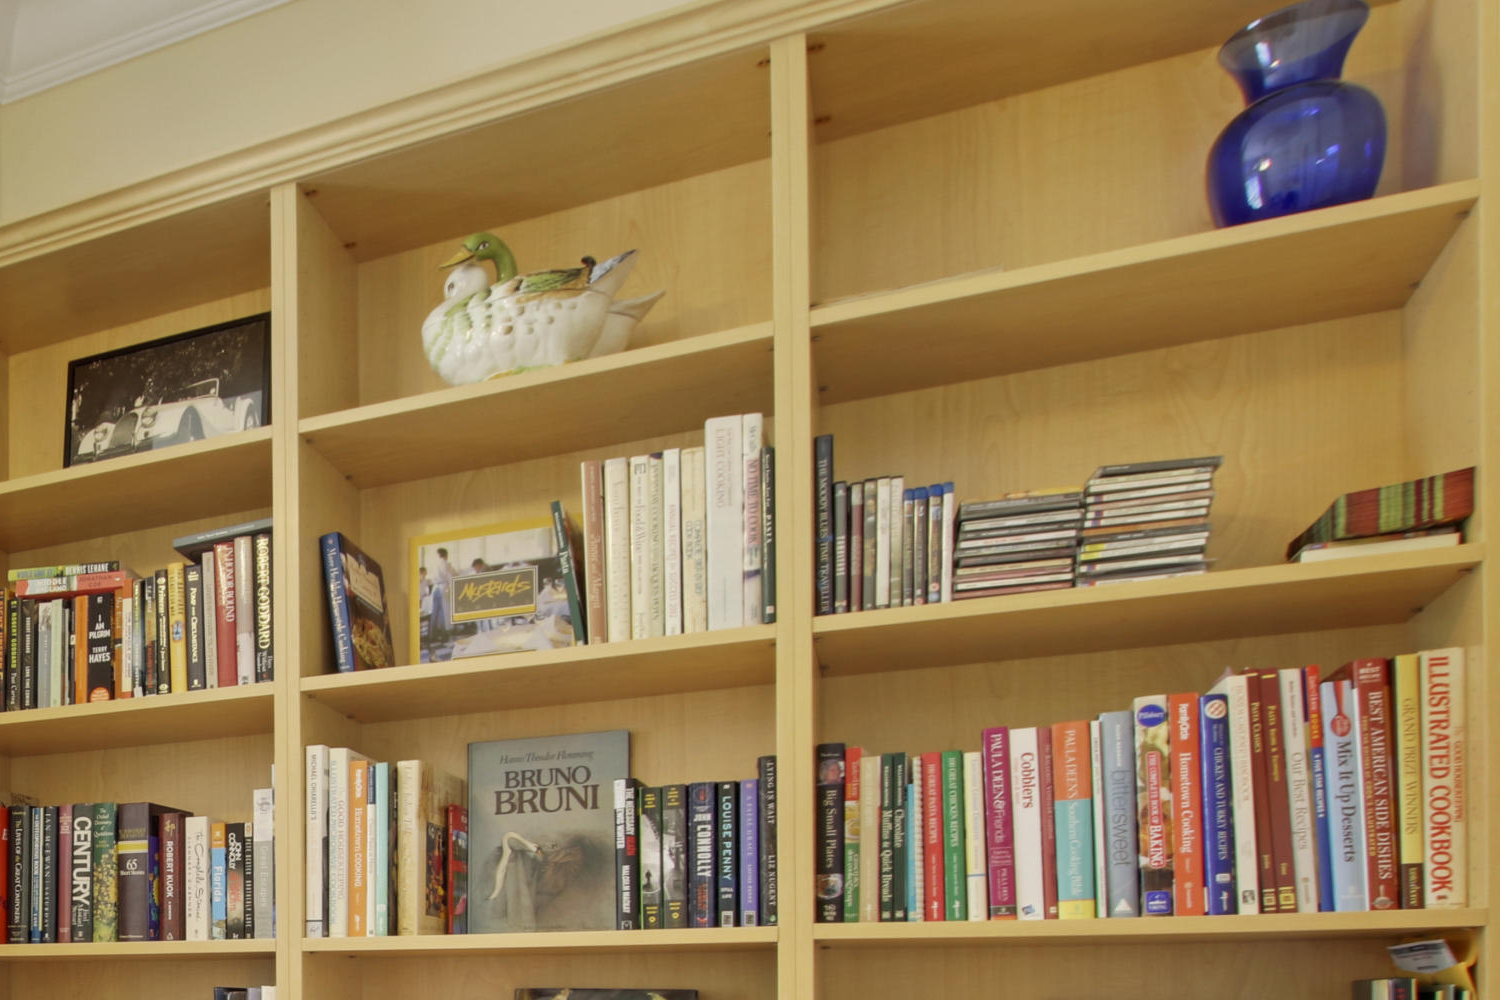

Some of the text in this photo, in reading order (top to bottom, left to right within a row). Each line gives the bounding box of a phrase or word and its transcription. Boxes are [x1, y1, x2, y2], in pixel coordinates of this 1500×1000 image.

[820, 512, 828, 539] BLUES
[256, 538, 269, 649] ROBERT GODDARD
[89, 629, 110, 638] PILGRIM
[95, 622, 104, 630] AM
[89, 652, 111, 663] HAYES
[990, 733, 1003, 769] PAULA
[1065, 729, 1077, 763] PAULA
[1213, 747, 1224, 781] CHICKEN
[505, 765, 591, 788] BRUNO
[1020, 752, 1035, 809] Cobblers
[1401, 697, 1418, 835] GRAND PRIZE WINNERS
[1427, 656, 1453, 893] ILLUSTRATED COOKBOOK
[494, 784, 600, 815] BRUNI
[1179, 752, 1195, 853] Hometown Cooking
[1215, 782, 1225, 798] AND
[1291, 752, 1308, 849] Our Best Recipes
[1335, 741, 1356, 863] Mix It Up Desserts
[1368, 691, 1392, 880] BEST AMERICAN SIDE DISHES
[826, 789, 838, 868] Big Small Plates
[894, 809, 903, 848] Chocolate
[929, 819, 937, 844] RECIPES
[950, 821, 958, 847] RECIPES
[1111, 769, 1132, 867] bittersweet
[697, 825, 711, 877] CONNOLLY
[722, 796, 732, 880] LOUISE PENNY
[881, 810, 892, 902] Muffins Quick Breads
[1149, 825, 1164, 867] BAKING
[1217, 831, 1228, 861] RECIPES
[73, 817, 91, 905] CENTURY
[126, 858, 138, 870] 65
[1067, 840, 1081, 875] Cooking
[214, 866, 223, 902] Florida
